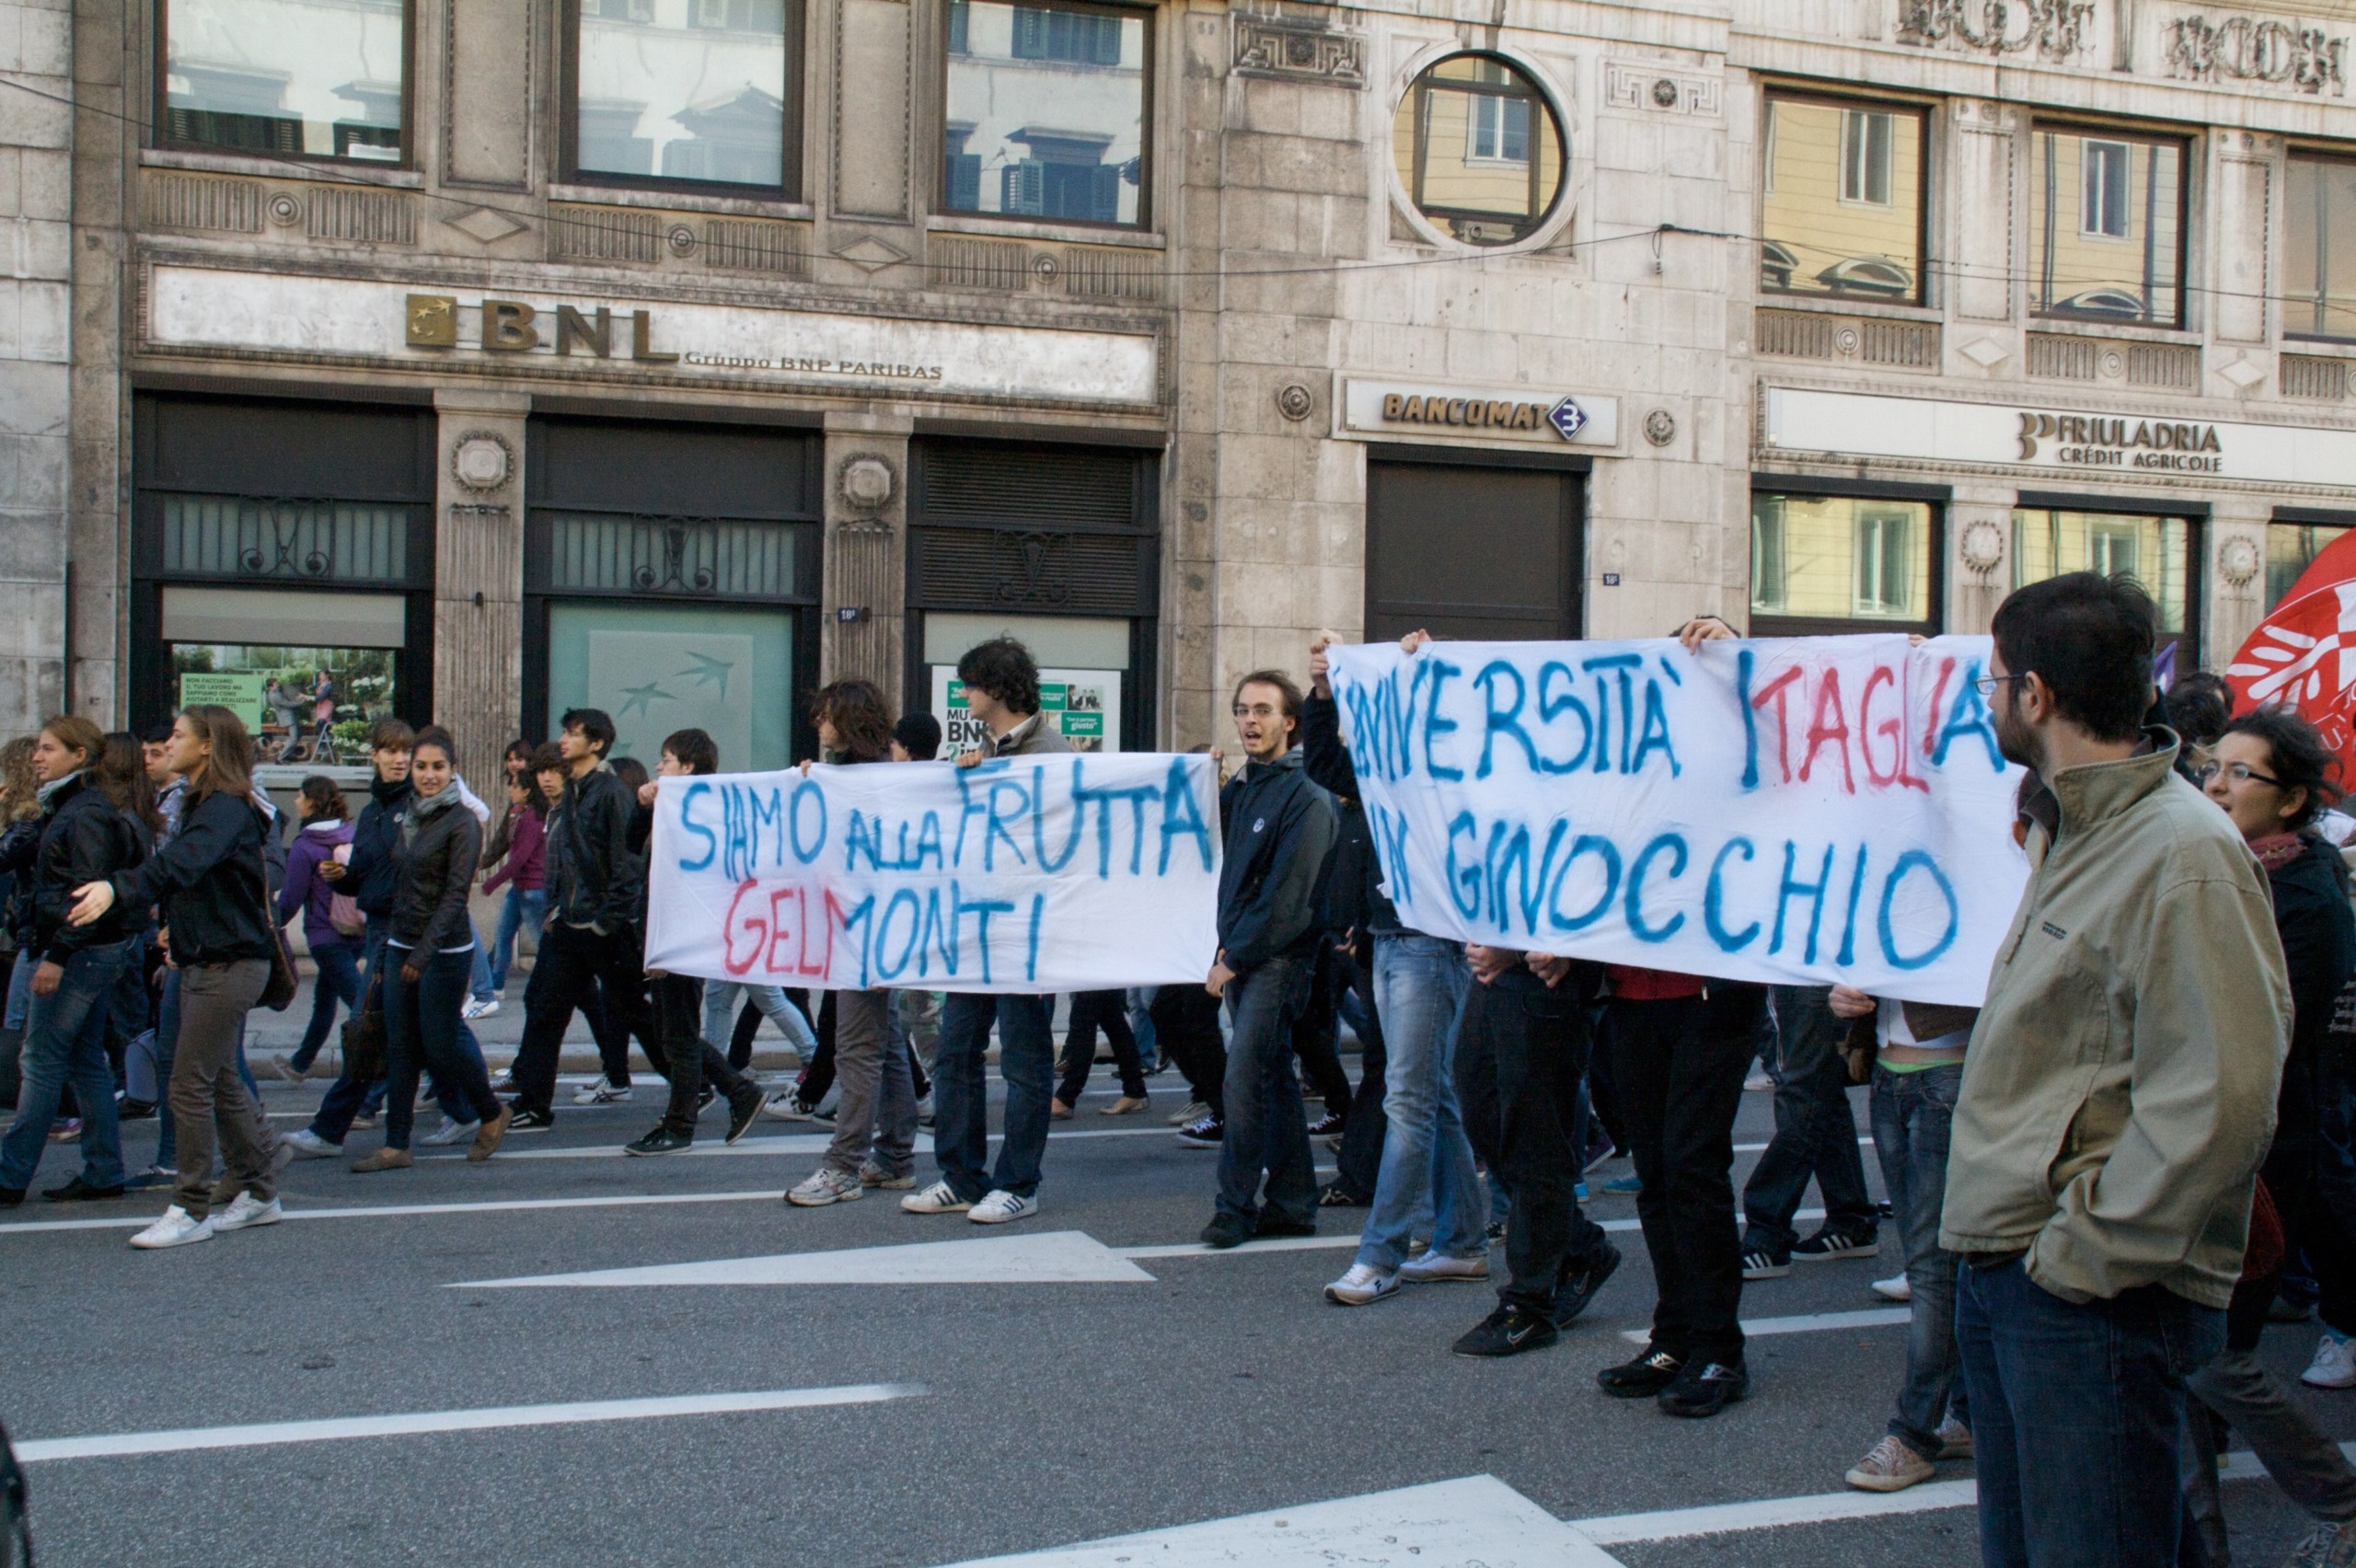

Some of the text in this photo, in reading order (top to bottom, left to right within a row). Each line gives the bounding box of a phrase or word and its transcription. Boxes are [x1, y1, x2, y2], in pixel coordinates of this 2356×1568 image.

[482, 299, 679, 363] BNL
[685, 351, 944, 380] Gruppo BNP PARIBAS
[1381, 393, 1550, 431] BANCOMAT
[2058, 415, 2223, 454] FRIULADRIA
[2058, 444, 2223, 473] CRÉDIT AGRICOLE
[680, 756, 1214, 882] SIAMO ALLA FRUTTA
[1445, 809, 1958, 971] GINOCCHIO
